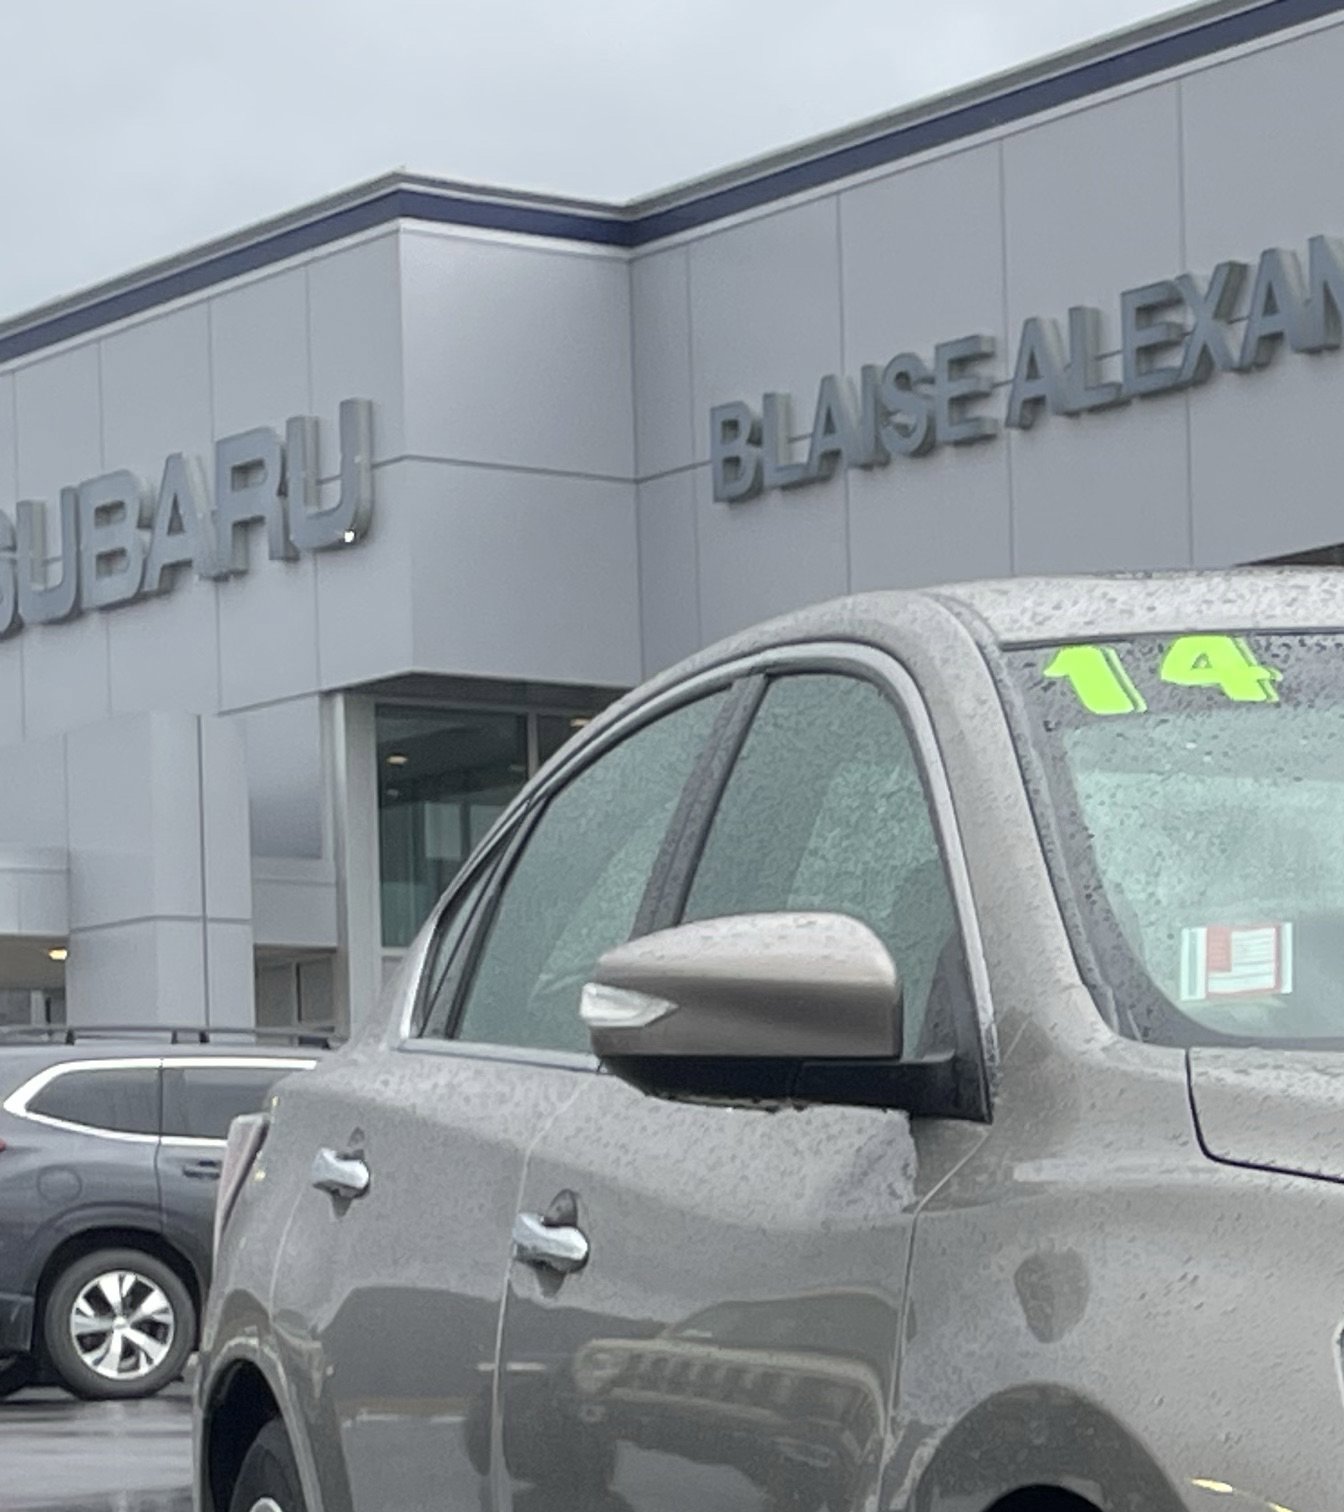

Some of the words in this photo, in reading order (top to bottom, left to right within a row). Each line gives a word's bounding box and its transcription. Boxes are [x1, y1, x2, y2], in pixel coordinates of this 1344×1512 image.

[709, 334, 999, 503] BLAISE
[0, 397, 374, 641] UBARU
[1043, 635, 1284, 714] 14
